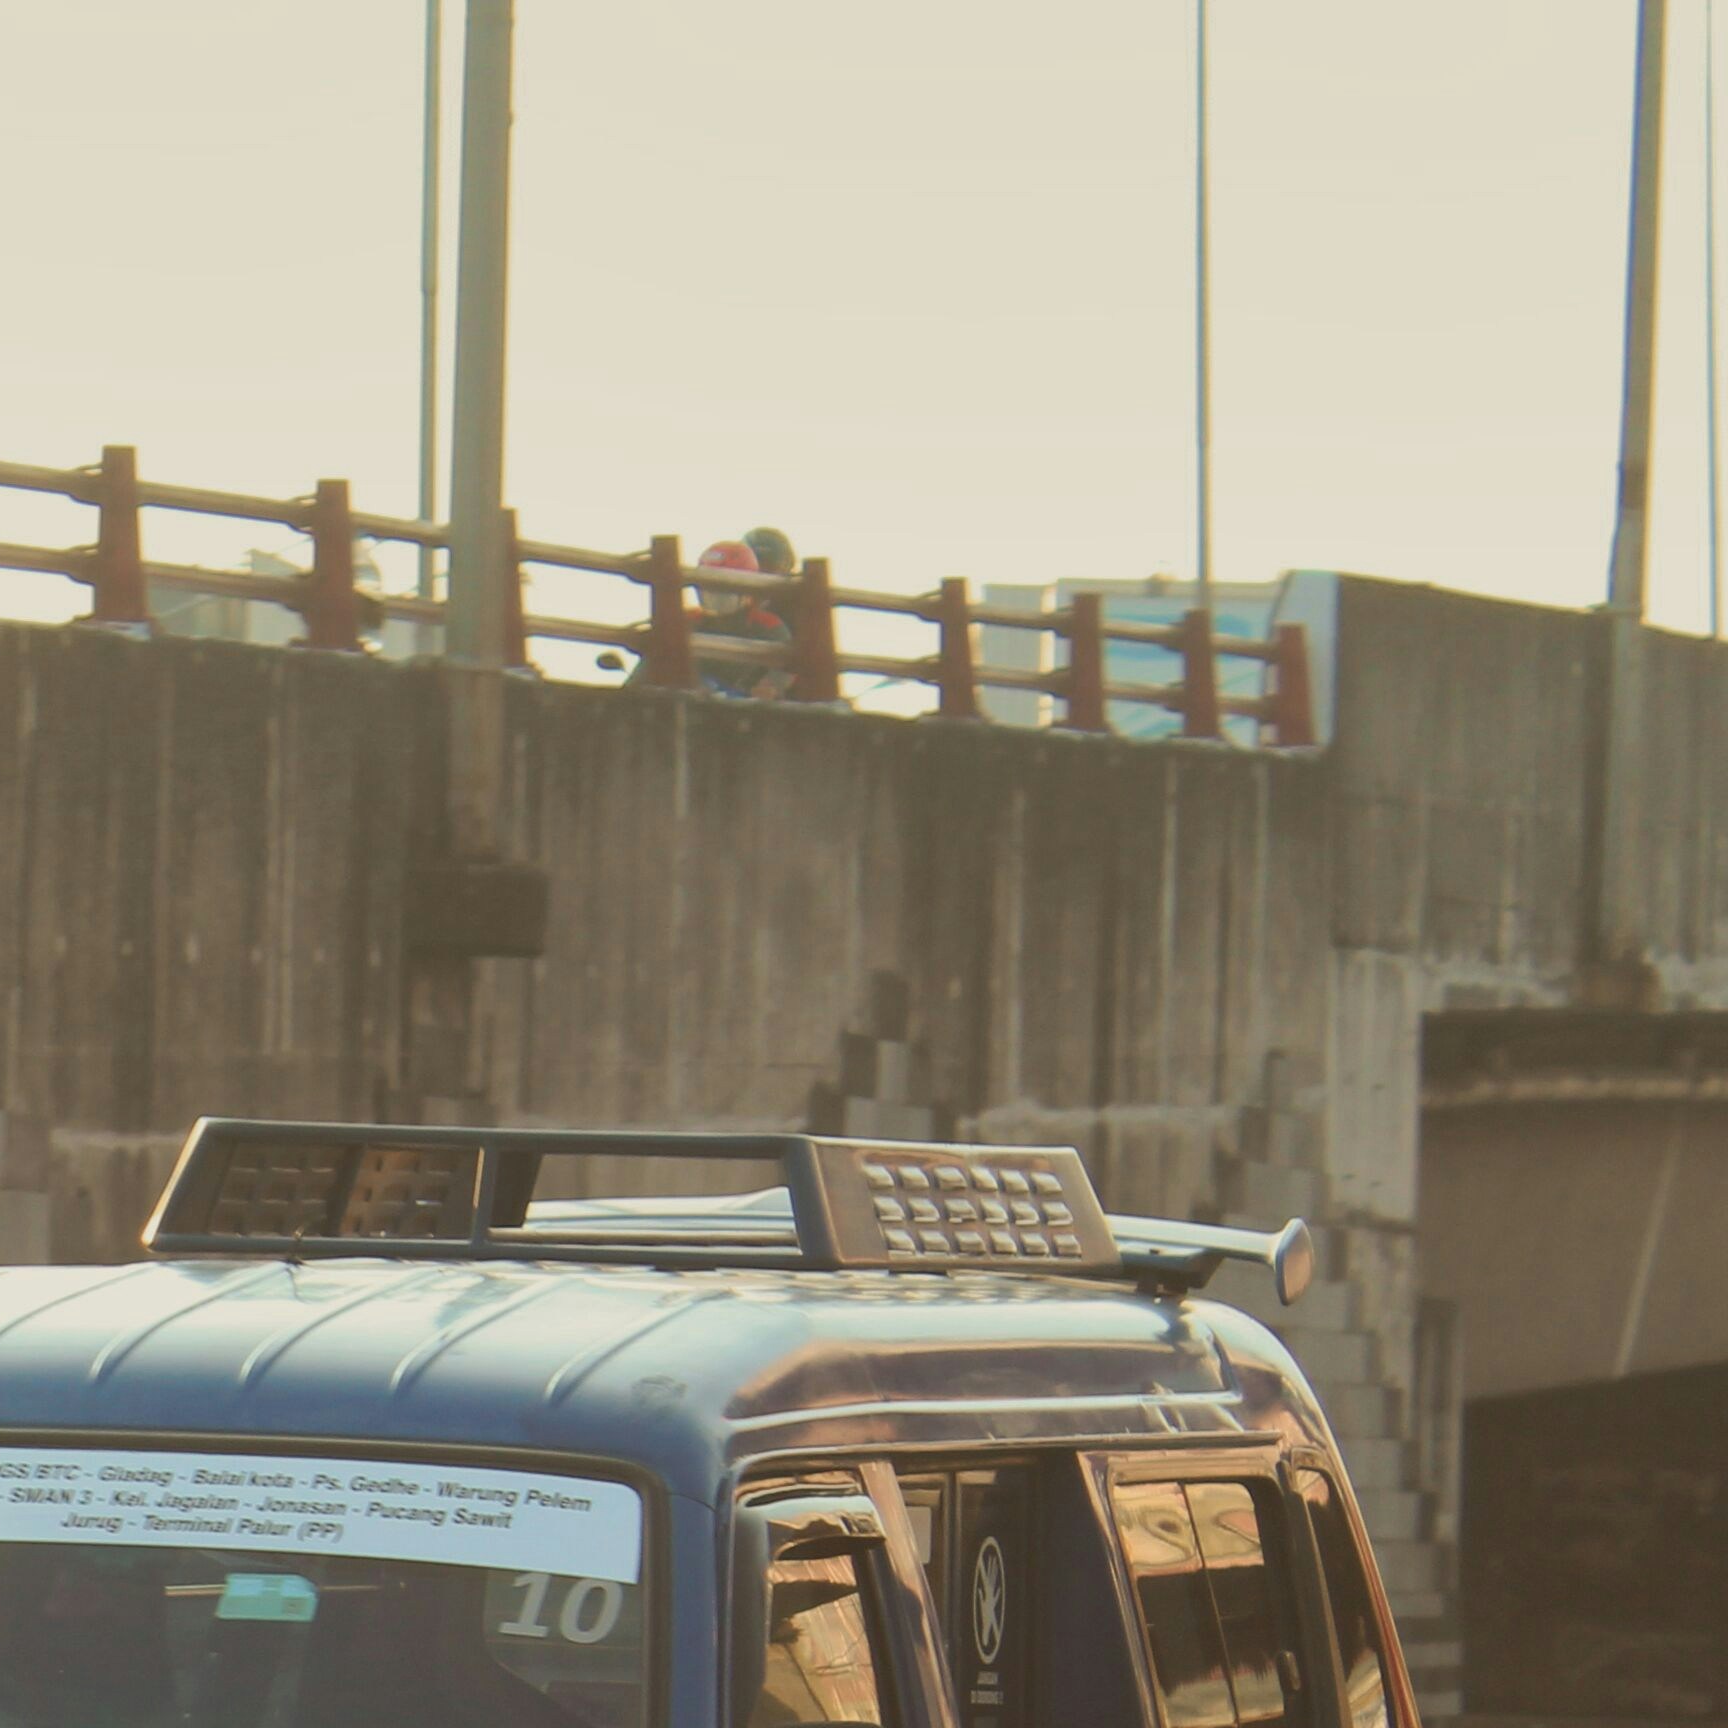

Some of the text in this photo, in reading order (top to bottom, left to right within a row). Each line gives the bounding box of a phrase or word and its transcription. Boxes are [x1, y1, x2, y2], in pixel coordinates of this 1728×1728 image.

[7, 1487, 76, 1504] SMAN
[77, 1489, 94, 1505] 3
[153, 1492, 240, 1513] Jagalan
[364, 1502, 447, 1527] Pucang
[452, 1507, 513, 1529] Sawit
[310, 1474, 344, 1490] Ps.
[349, 1475, 420, 1495] Gedhe
[435, 1481, 519, 1507] Warung
[524, 1489, 592, 1512] Pelem
[60, 1512, 124, 1534] Jurug
[143, 1514, 234, 1533] Terminal
[235, 1517, 293, 1536] Palur
[296, 1520, 344, 1544] (PP)
[498, 1572, 623, 1644] 10
